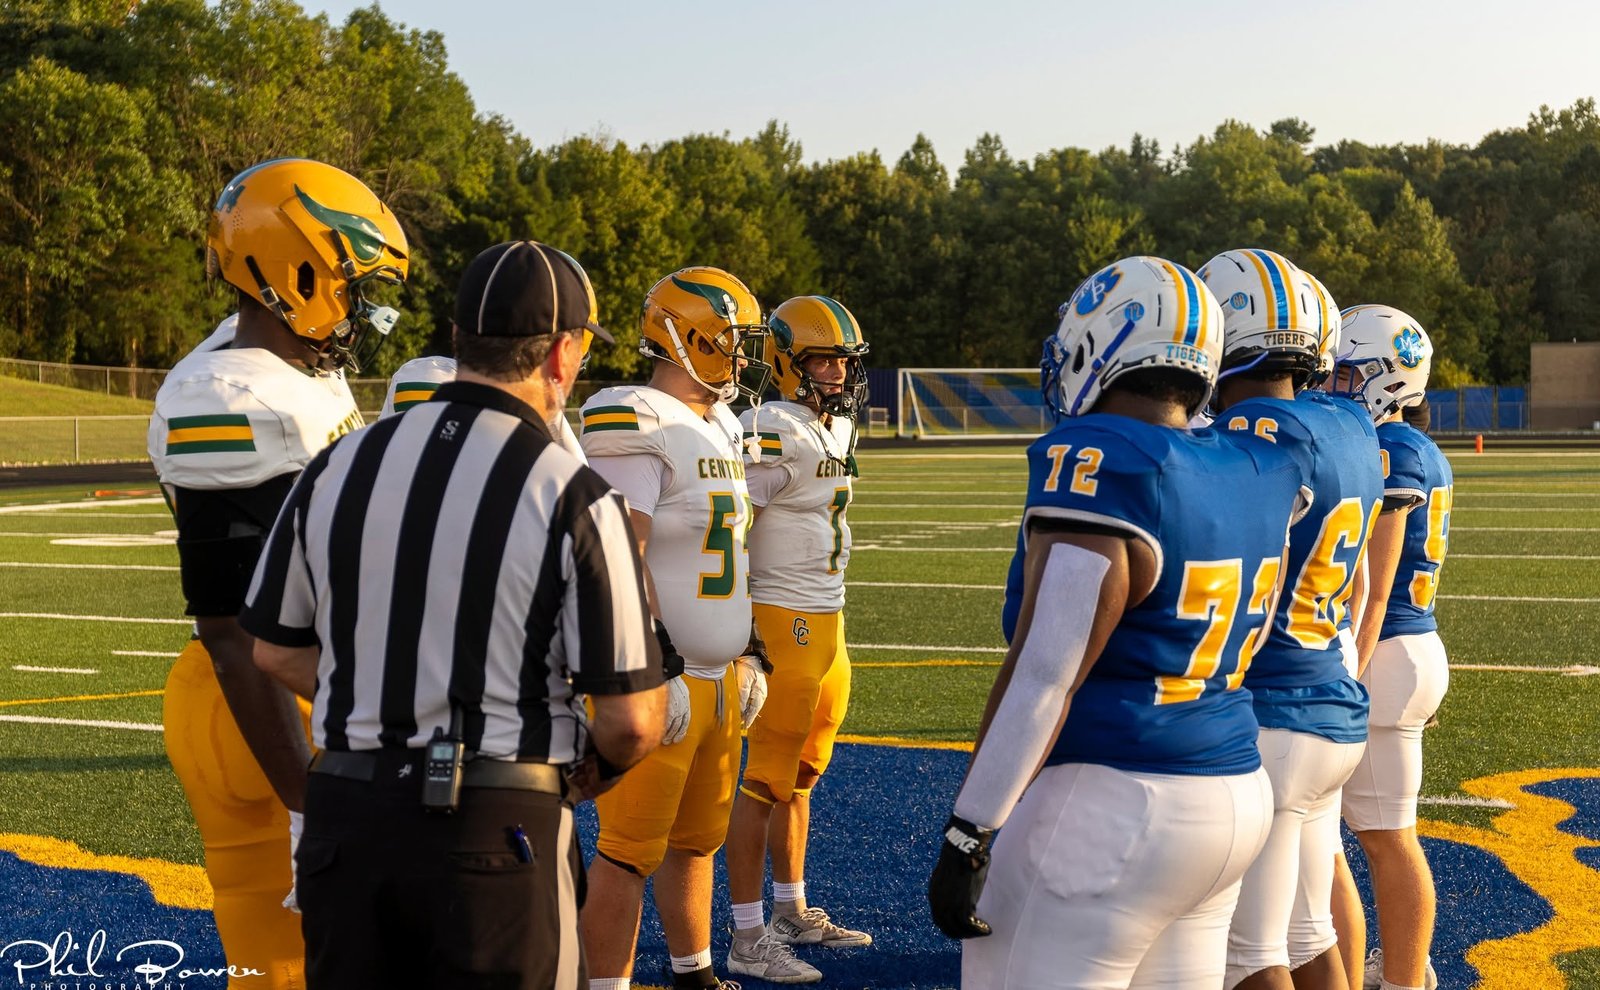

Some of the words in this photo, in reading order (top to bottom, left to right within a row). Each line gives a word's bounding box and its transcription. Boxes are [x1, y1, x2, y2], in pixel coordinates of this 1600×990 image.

[1263, 332, 1306, 347] TIGERS
[1043, 444, 1105, 498] 72
[697, 491, 752, 599] 5
